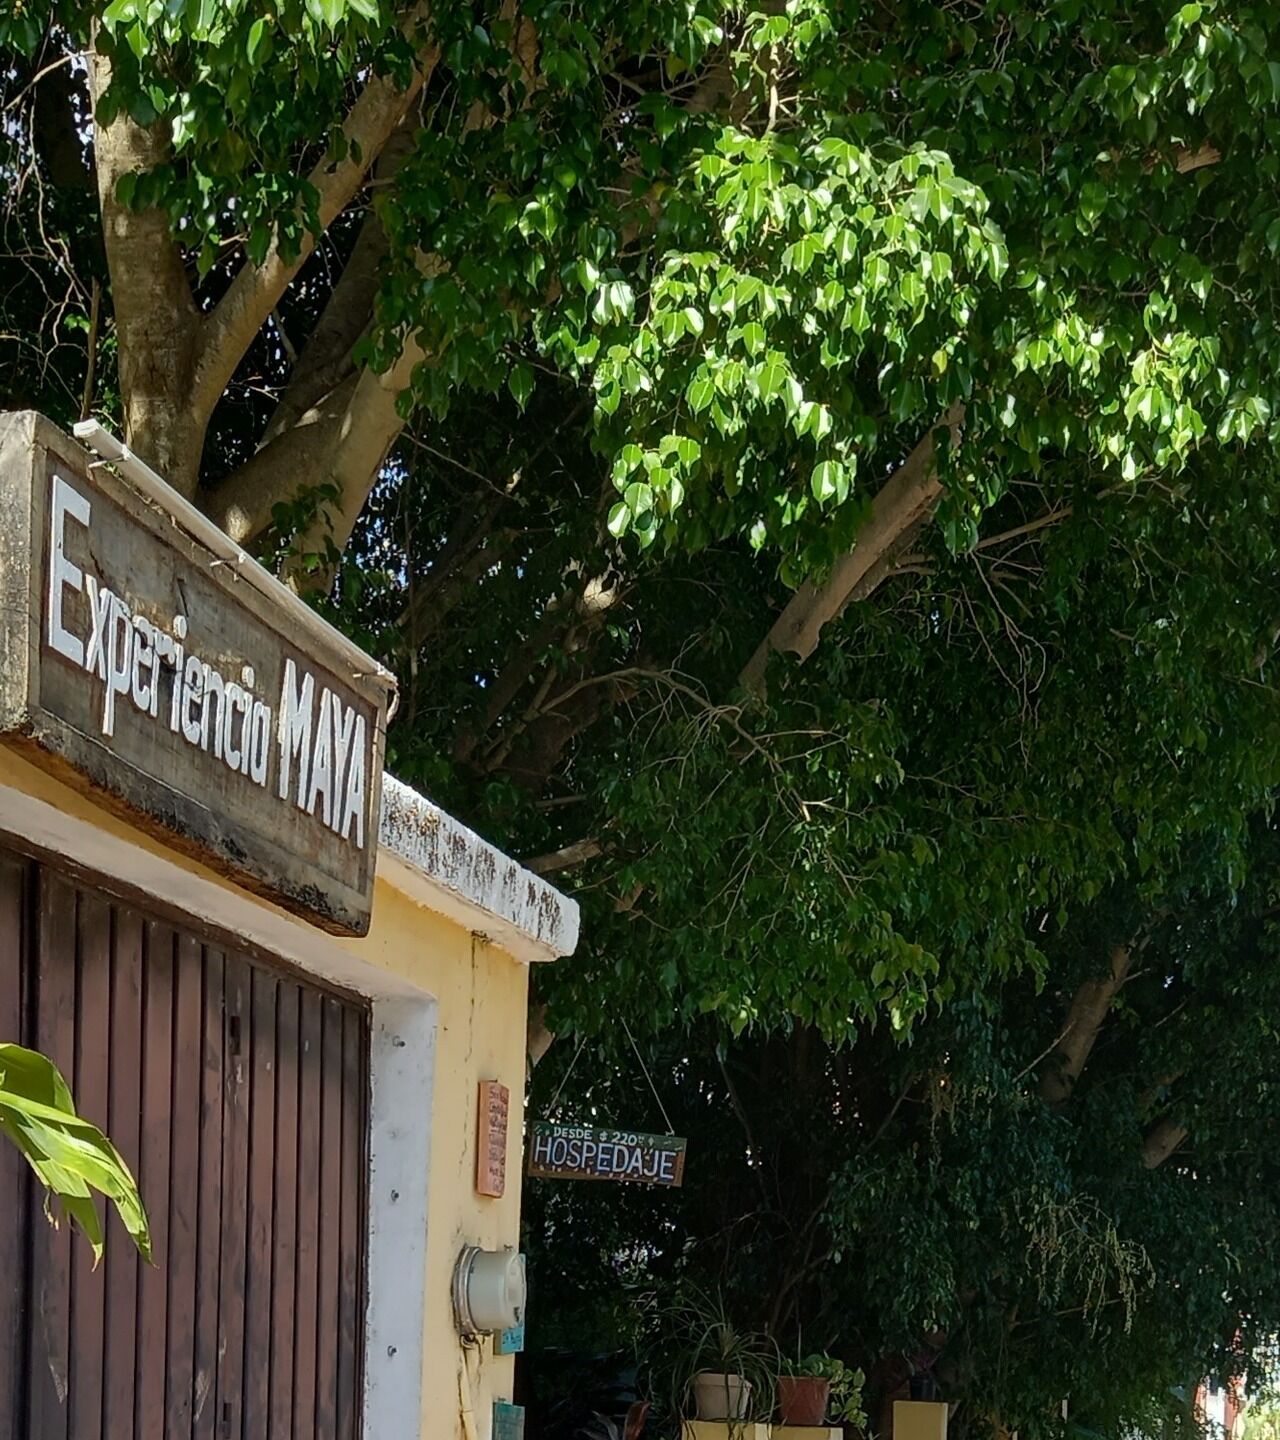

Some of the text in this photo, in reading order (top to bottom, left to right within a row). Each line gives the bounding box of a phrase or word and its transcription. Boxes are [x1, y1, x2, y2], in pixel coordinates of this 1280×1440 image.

[48, 474, 366, 849] Experiencia MAYA
[553, 1126, 593, 1140] DESDE
[533, 1135, 676, 1179] HOSPEDAJE
